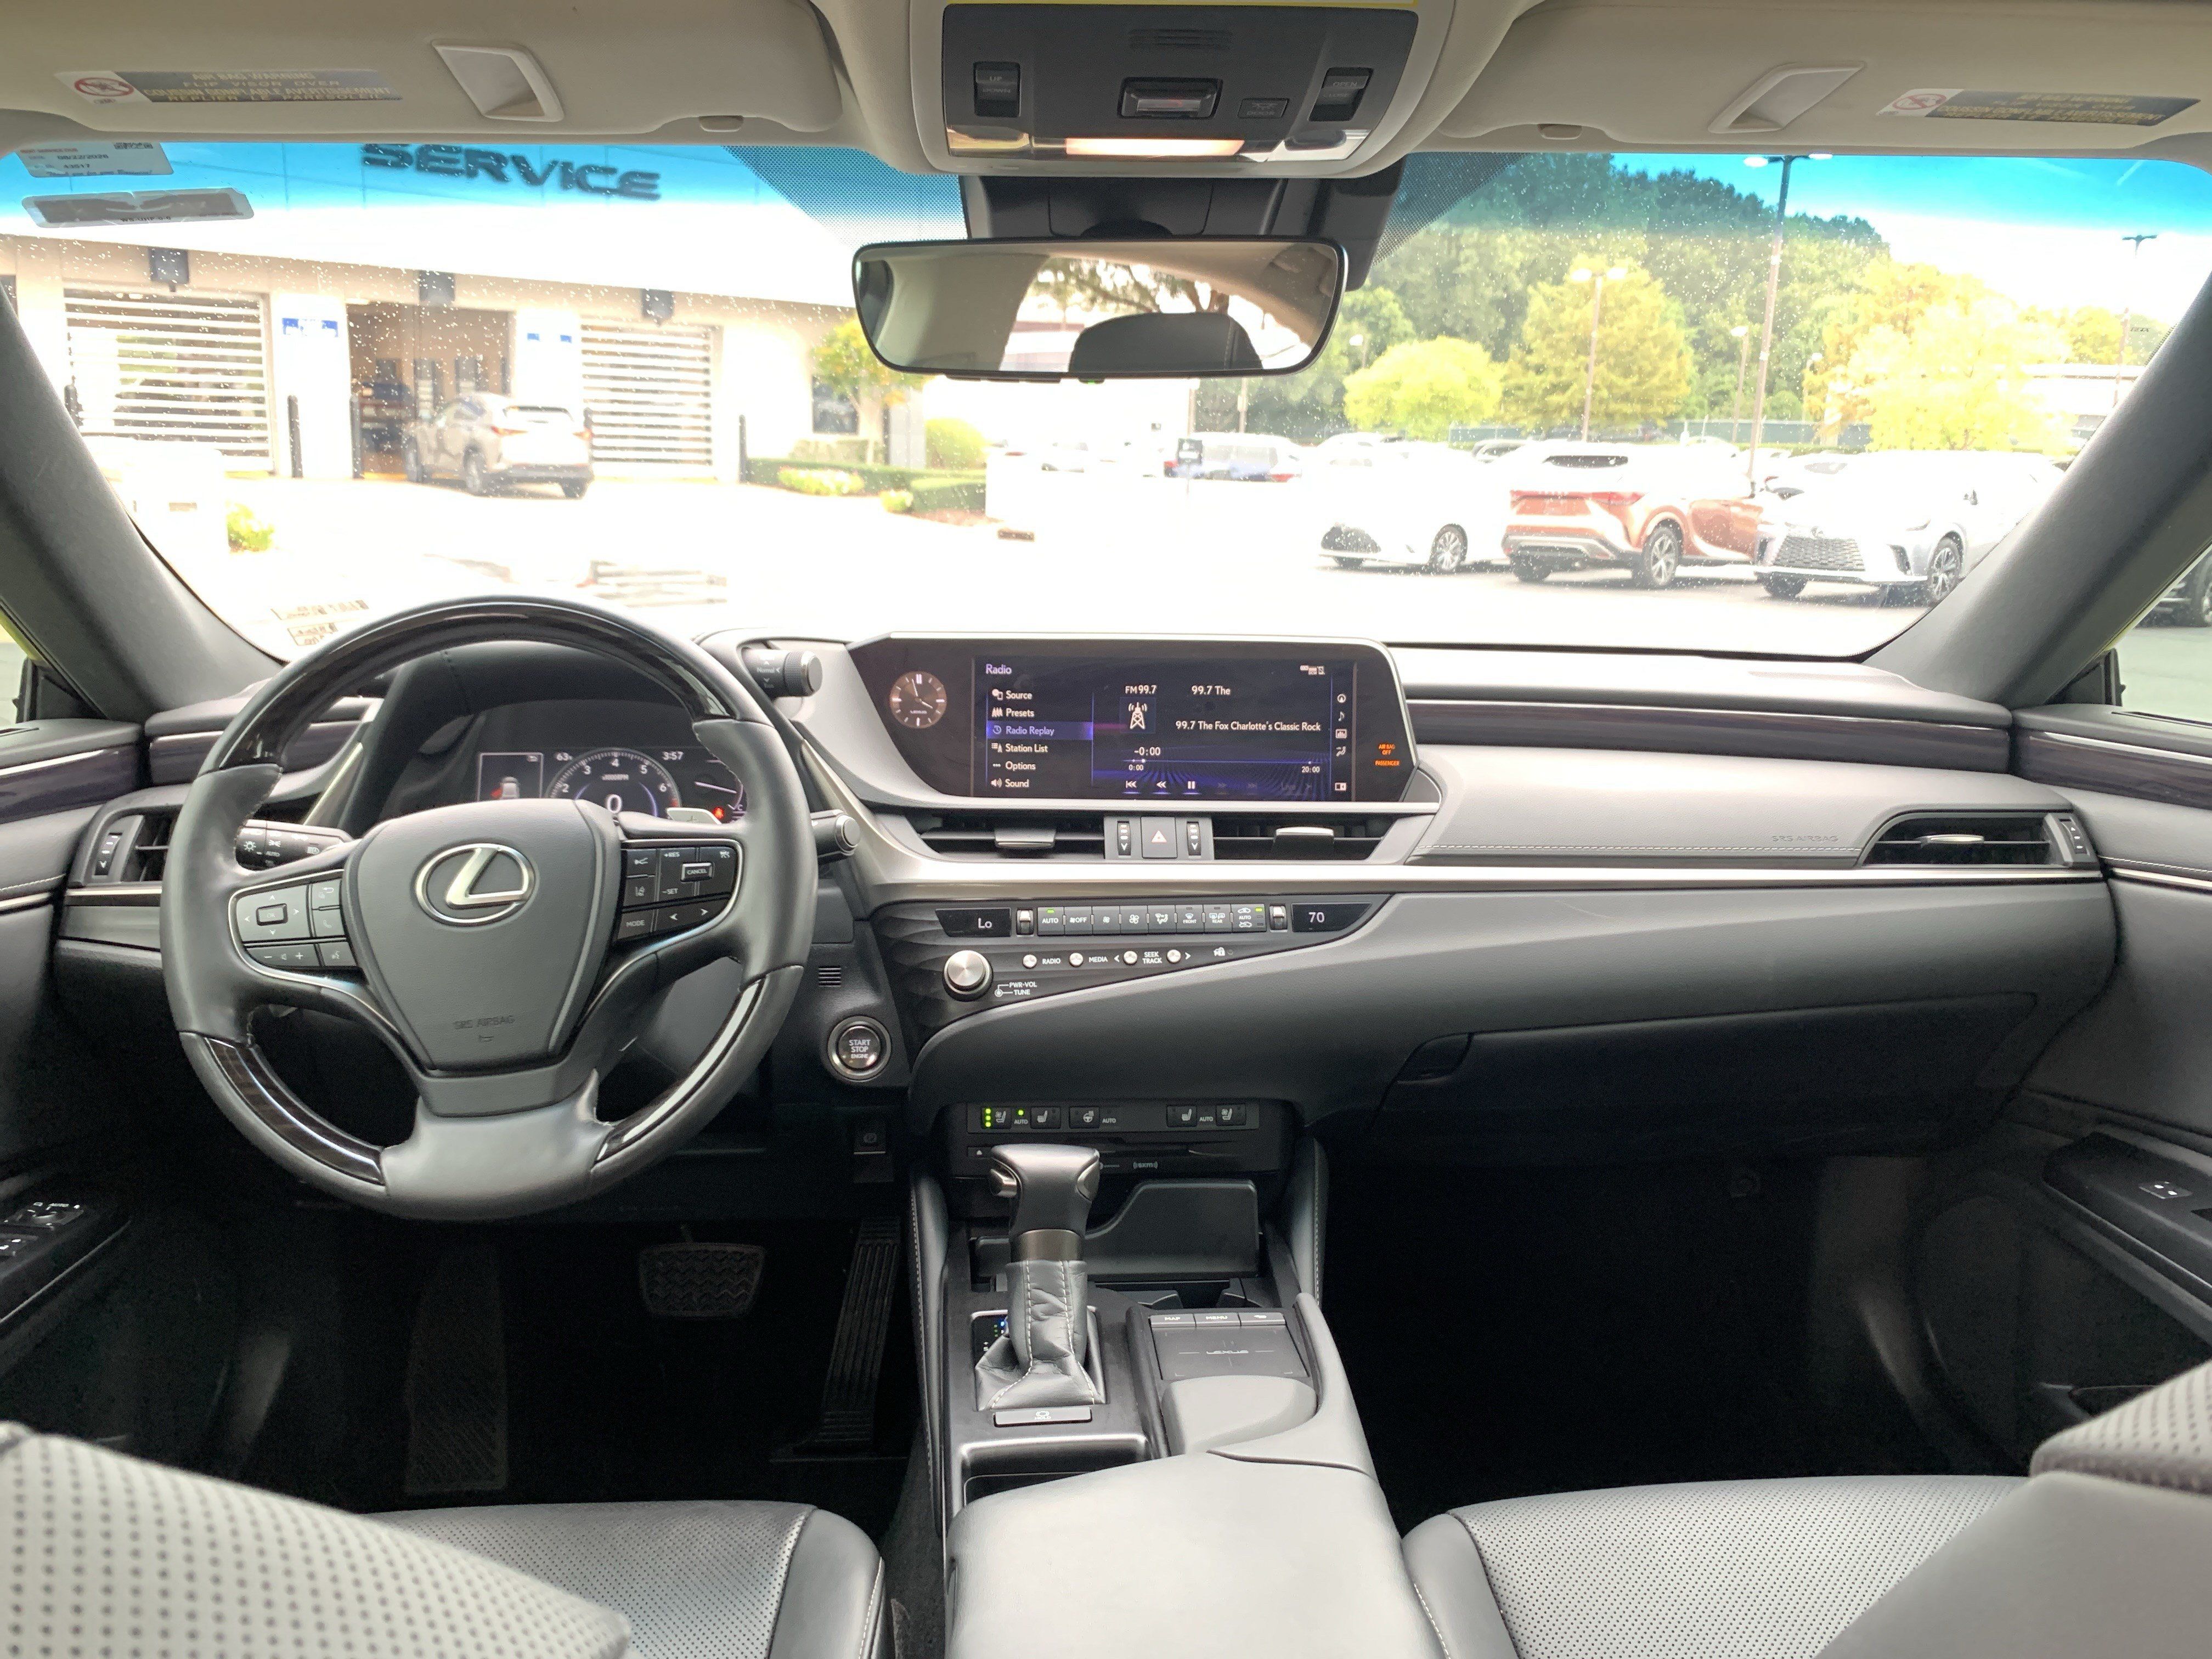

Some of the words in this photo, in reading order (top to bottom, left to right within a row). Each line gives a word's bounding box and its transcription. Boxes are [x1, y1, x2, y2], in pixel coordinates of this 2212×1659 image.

[363, 143, 662, 201] SERVICE
[986, 664, 1012, 674] Radio
[1006, 690, 1032, 699] Source
[1192, 685, 1212, 695] 99.7
[1214, 686, 1231, 695] The
[1006, 708, 1034, 717] Presets
[1006, 725, 1028, 735] Radio
[1029, 725, 1054, 736] Replay
[1175, 720, 1196, 730] 99.7
[1198, 721, 1213, 730] The
[1215, 721, 1229, 730] Fox
[1231, 721, 1272, 731] Charlotte's
[1274, 721, 1300, 731] Classic
[1301, 722, 1321, 731] Rock
[1005, 743, 1033, 753] Station
[1034, 743, 1048, 753] List
[663, 751, 684, 761] 3:57
[611, 758, 619, 767] 4
[1005, 760, 1036, 771] Options
[583, 765, 591, 775] 3
[640, 764, 648, 774] 5
[659, 783, 667, 792] 6
[1005, 778, 1030, 787] Sound
[562, 783, 569, 793] 2
[606, 794, 622, 814] 0
[1308, 912, 1325, 923] 70
[978, 918, 992, 929] Lo
